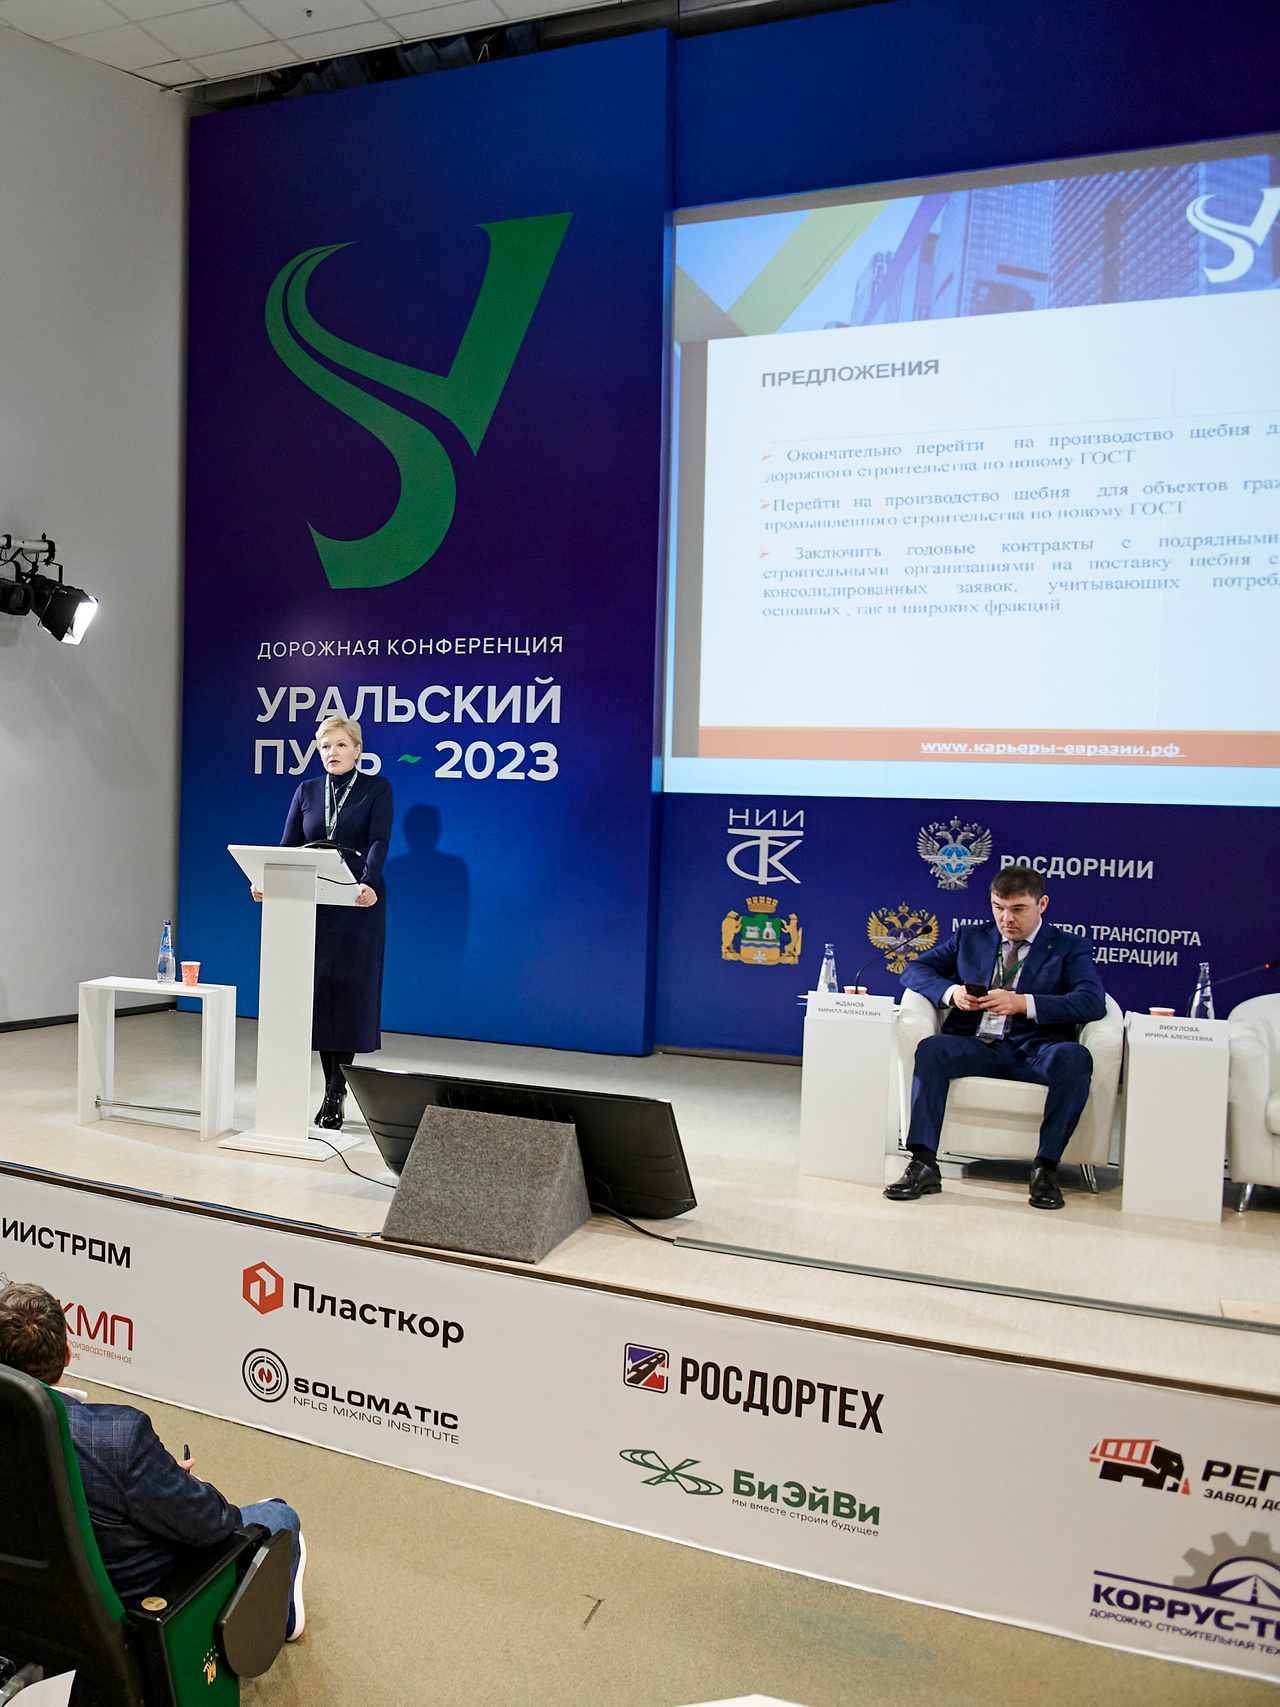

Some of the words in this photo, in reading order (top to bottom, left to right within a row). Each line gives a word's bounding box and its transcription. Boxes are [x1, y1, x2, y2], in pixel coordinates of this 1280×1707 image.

[761, 359, 940, 388] ПРЕДЛОЖЕНИЯ
[787, 446, 902, 463] Окончательно
[916, 440, 985, 457] перейти
[1014, 438, 1035, 449] на
[1049, 430, 1174, 450] производство
[1190, 424, 1251, 440] щебня
[765, 468, 852, 484] дорожного
[857, 461, 977, 479] строительства
[983, 460, 1004, 471] по
[1010, 457, 1073, 470] новому
[1080, 449, 1136, 465] ГОСТ
[773, 497, 841, 514] Перейти
[853, 498, 872, 508] на
[885, 491, 1000, 510] производство
[1014, 486, 1070, 501] щебня
[1097, 485, 1129, 498] для
[1142, 480, 1228, 495] объектов
[765, 515, 898, 534] промышленного
[902, 510, 1024, 528] строительства
[1031, 509, 1052, 520] по
[1058, 506, 1123, 520] новому
[1130, 500, 1187, 516] ГОСТ
[795, 546, 882, 560] Заключить
[906, 543, 976, 557] годовые
[1001, 539, 1094, 555] контракты
[1121, 538, 1131, 549] с
[1159, 533, 1279, 550] подрядными
[763, 565, 889, 582] строительными
[904, 561, 1035, 578] организациями
[1052, 560, 1073, 571] на
[1089, 557, 1172, 572] поставку
[1190, 554, 1251, 568] щебня
[763, 584, 928, 599] консолидированных
[1048, 577, 1180, 595] учитывающих
[1213, 573, 1280, 590] потреб
[762, 605, 841, 617] основных
[855, 605, 882, 615] так
[887, 605, 897, 615] и
[902, 603, 979, 617] широких
[984, 599, 1061, 617] фракций
[257, 639, 379, 660] ДОРОЖНАЯ
[387, 636, 564, 656] КОНФЕРЕНЦИЯ
[256, 676, 561, 723] УРАЛЬСКИЙ
[254, 739, 382, 776] ПУЬ
[434, 740, 559, 781] 2023
[729, 808, 804, 828] НИИ
[1090, 925, 1202, 946] ТРАНСПОРТА
[835, 1000, 865, 1008] ЖДАНОВ
[843, 1009, 881, 1017] АЛЕКСЕЕВИЧ
[1159, 1024, 1200, 1033] ВИКУЛОВА
[1169, 1034, 1214, 1042] АЛЕКСЕЕВНА
[293, 1282, 465, 1348] Пласткор
[293, 1377, 459, 1430] SOLOMATIC
[680, 1356, 885, 1434] РОСДОРТЕХ
[293, 1396, 328, 1412] NFLG
[333, 1405, 382, 1426] MIXING
[387, 1419, 460, 1445] INSTITUTE
[732, 1469, 880, 1526] БиЭйВи
[1203, 1488, 1258, 1508] ЗАВОД
[731, 1498, 747, 1508] мы
[750, 1502, 787, 1517] вместе
[789, 1511, 828, 1526] строим
[831, 1519, 879, 1537] будущее
[1089, 1608, 1153, 1629] ДОРОЖНО
[1156, 1622, 1255, 1651] СТРОИТЕЛЬНАЯ
